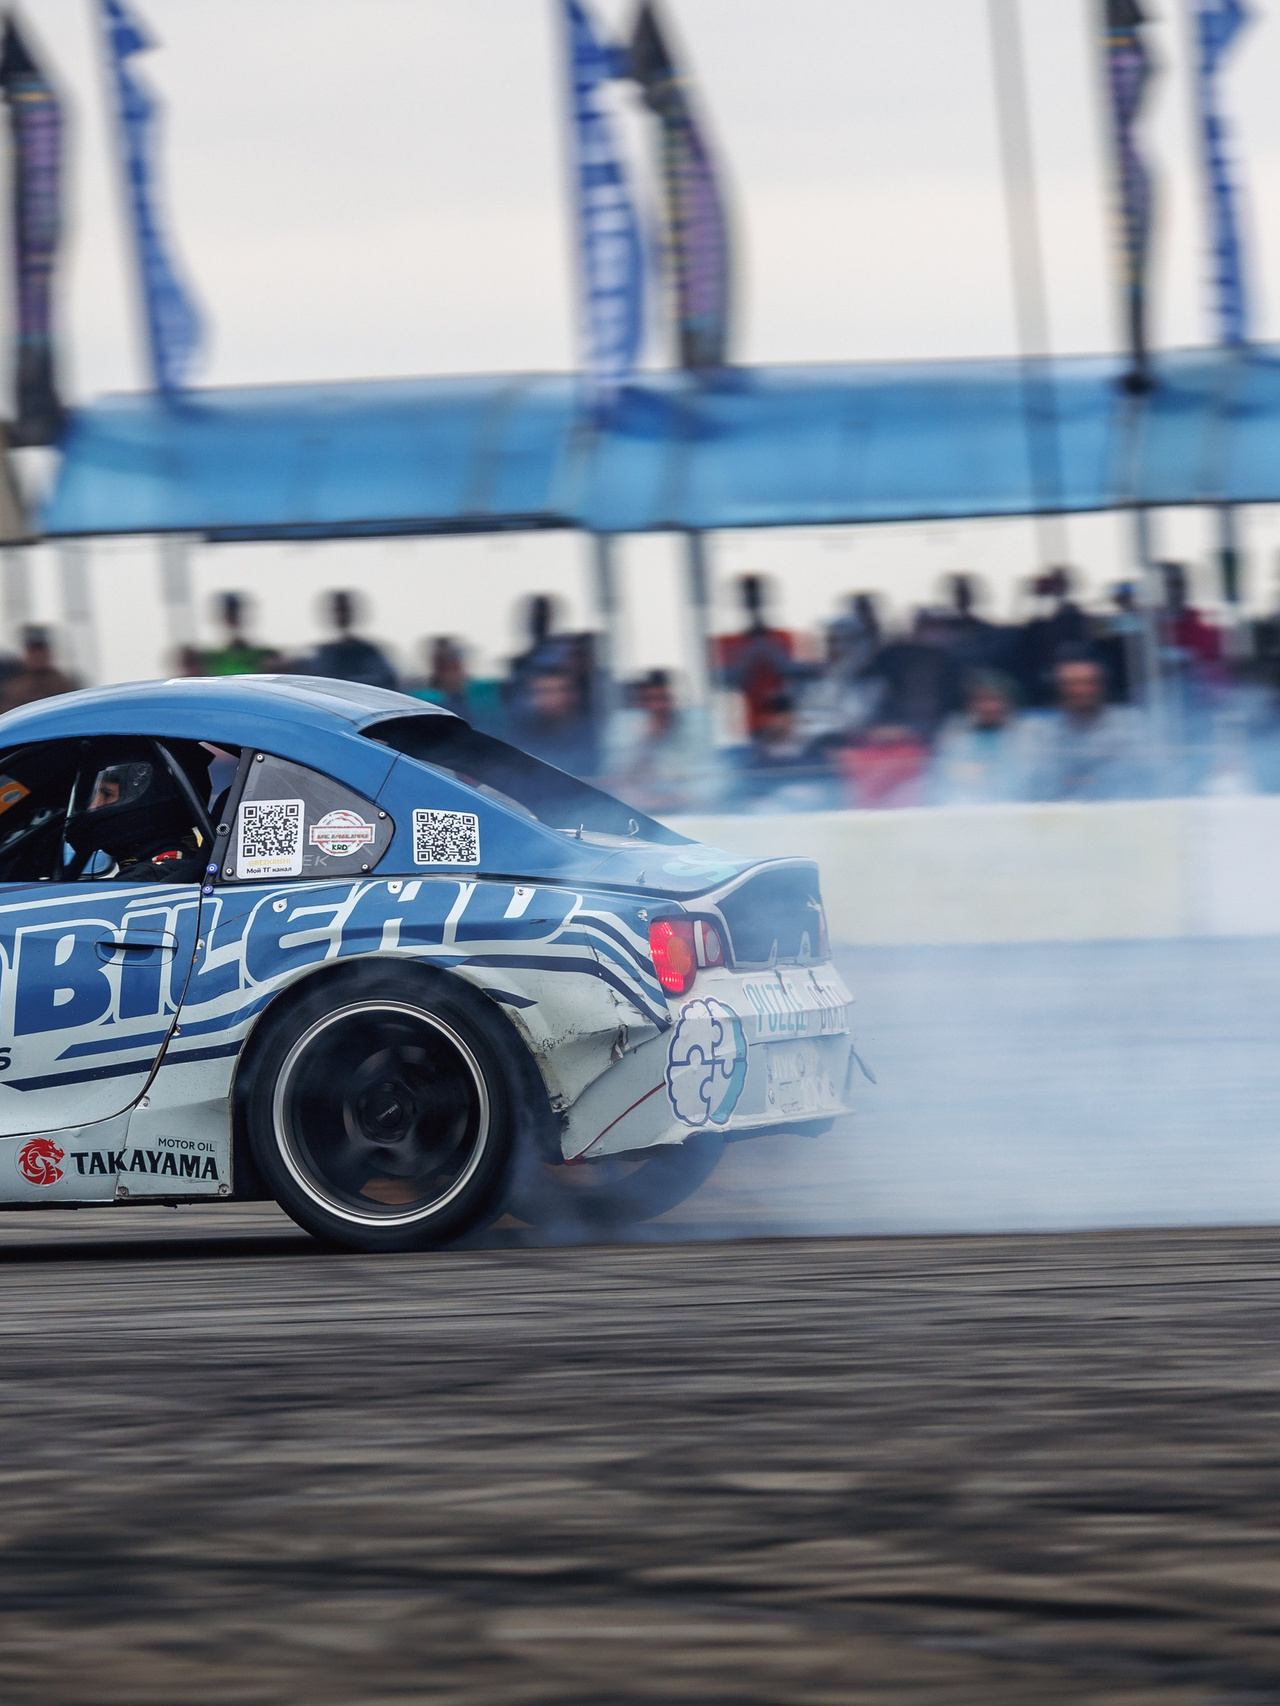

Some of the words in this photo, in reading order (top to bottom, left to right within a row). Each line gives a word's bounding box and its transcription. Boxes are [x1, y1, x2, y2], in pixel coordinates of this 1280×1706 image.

[158, 1137, 195, 1150] MOTOR
[197, 1142, 215, 1152] OIL
[71, 1148, 219, 1180] TAKAYAMA
